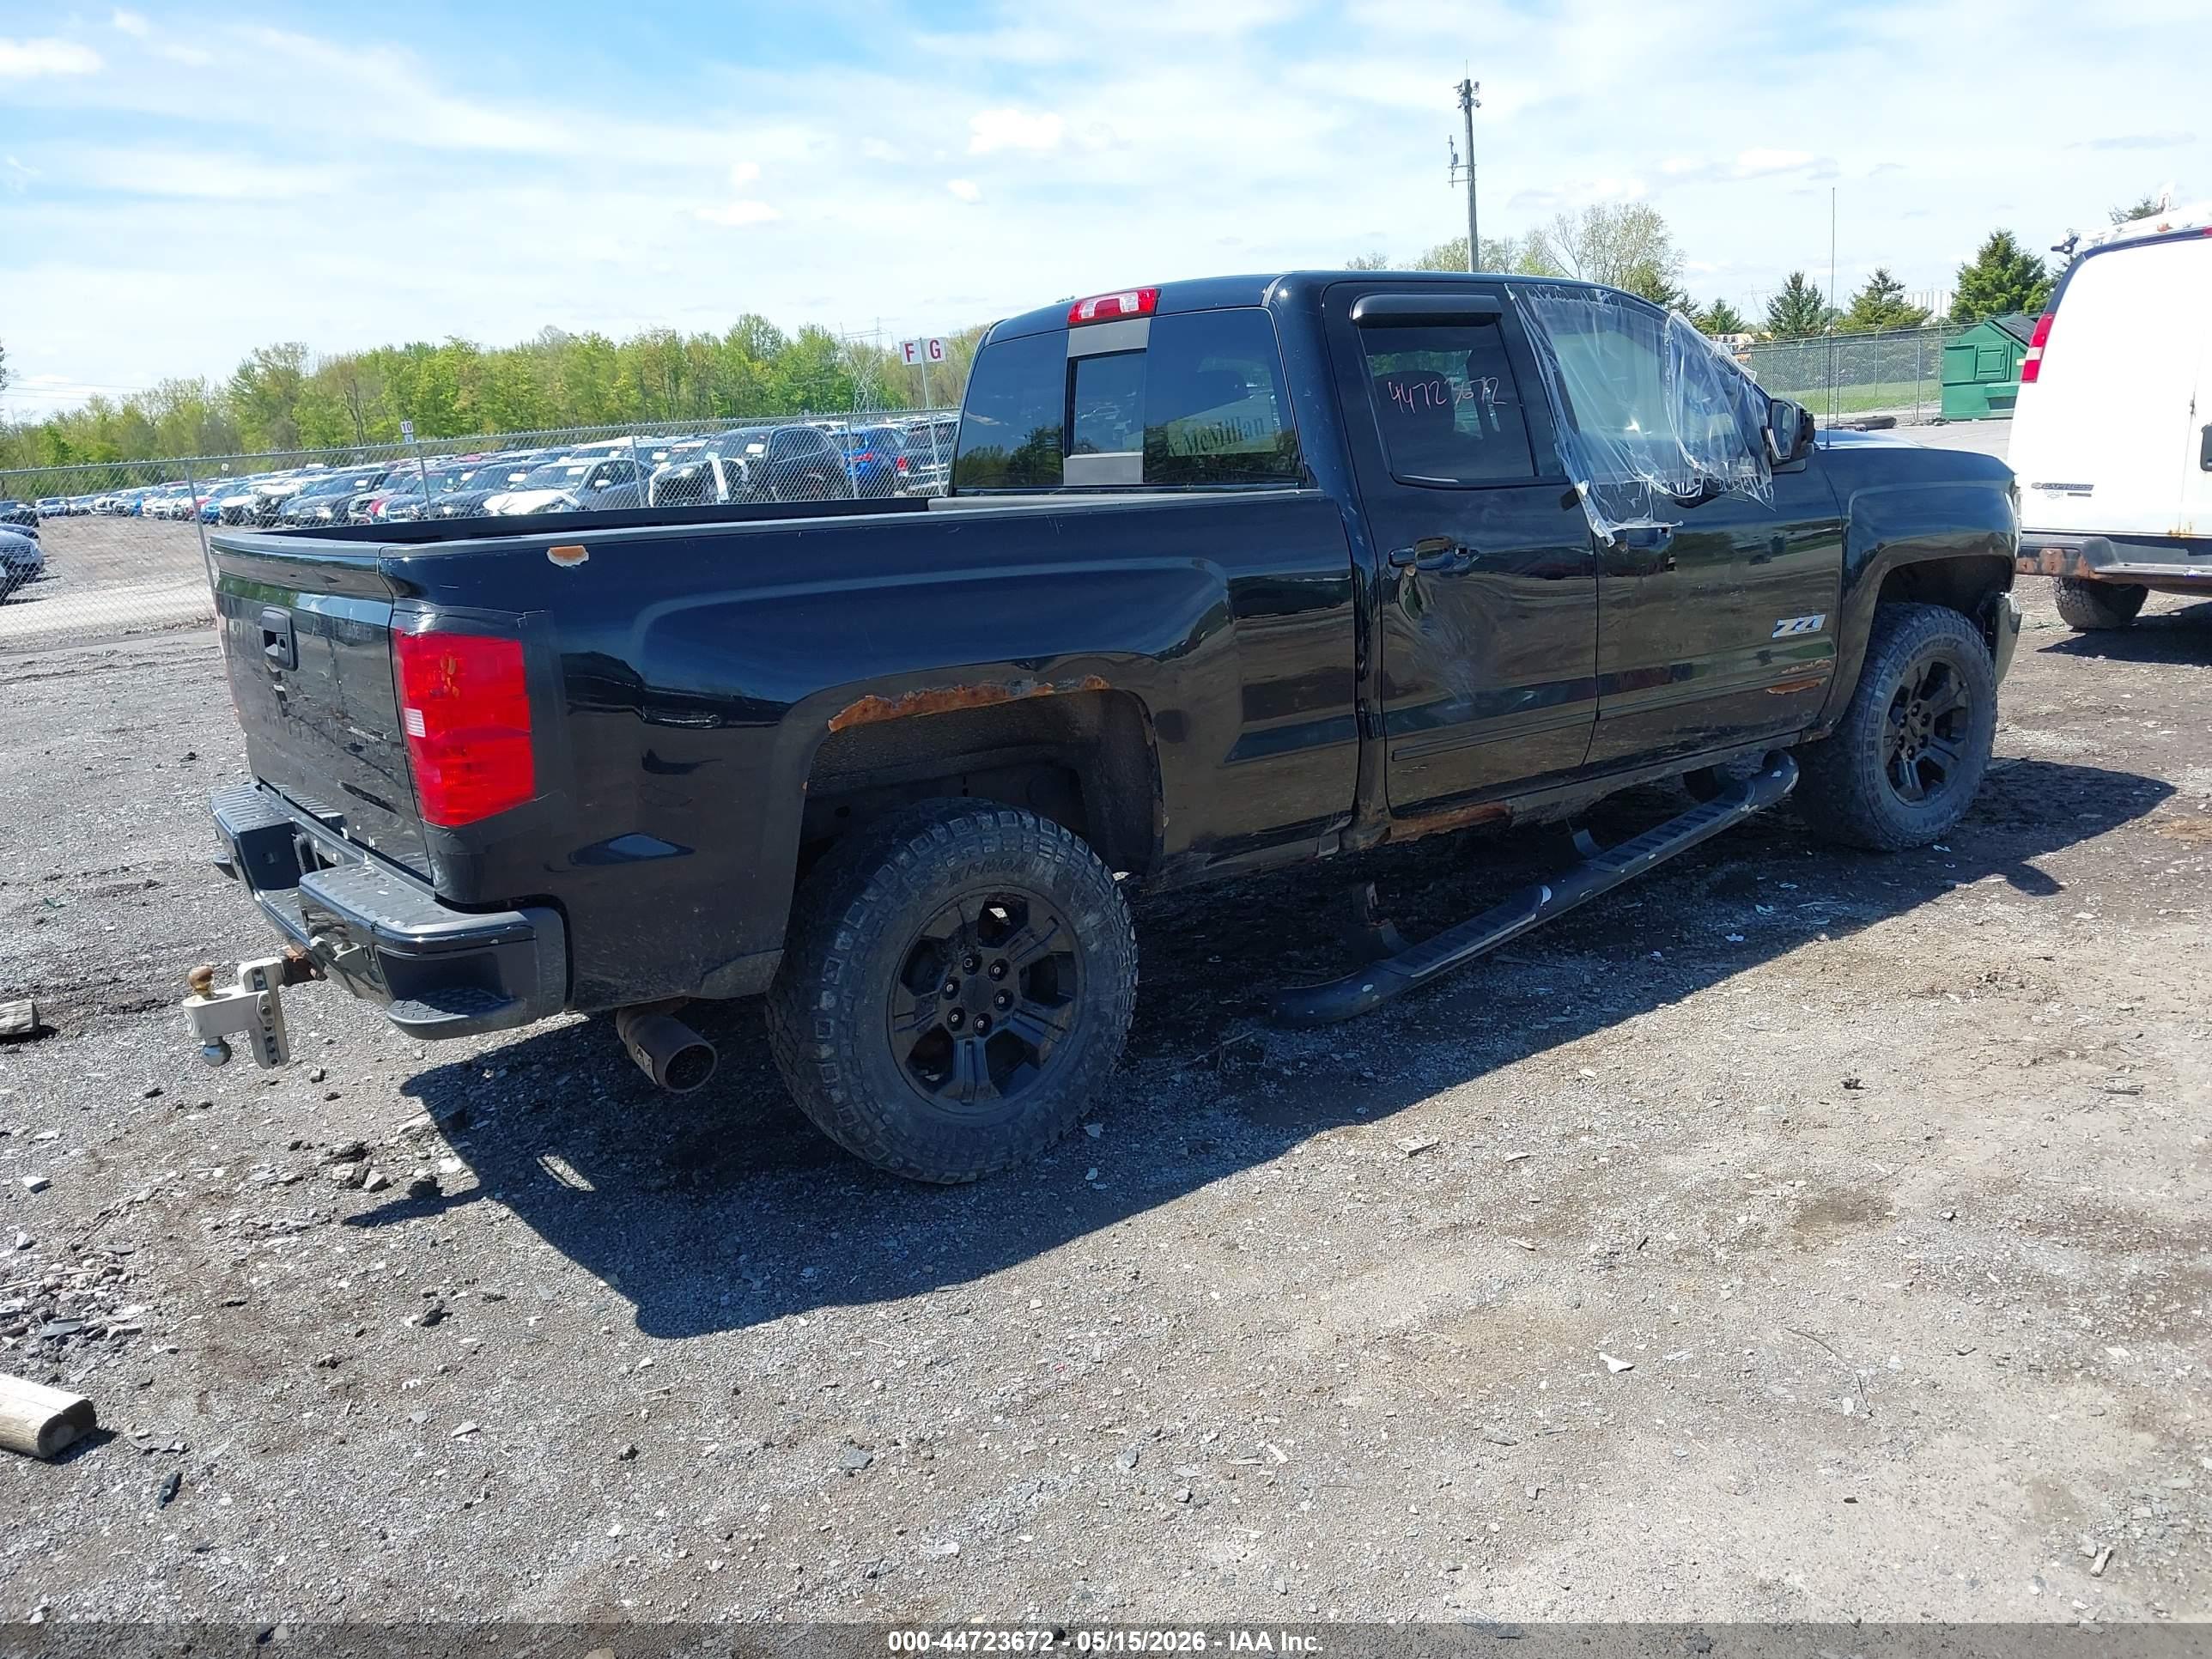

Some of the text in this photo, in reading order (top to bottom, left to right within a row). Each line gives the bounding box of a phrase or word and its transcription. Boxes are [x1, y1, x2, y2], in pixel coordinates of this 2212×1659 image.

[904, 343, 915, 362] F
[929, 339, 941, 360] G
[402, 422, 412, 432] 10
[1771, 614, 1826, 639] Z71
